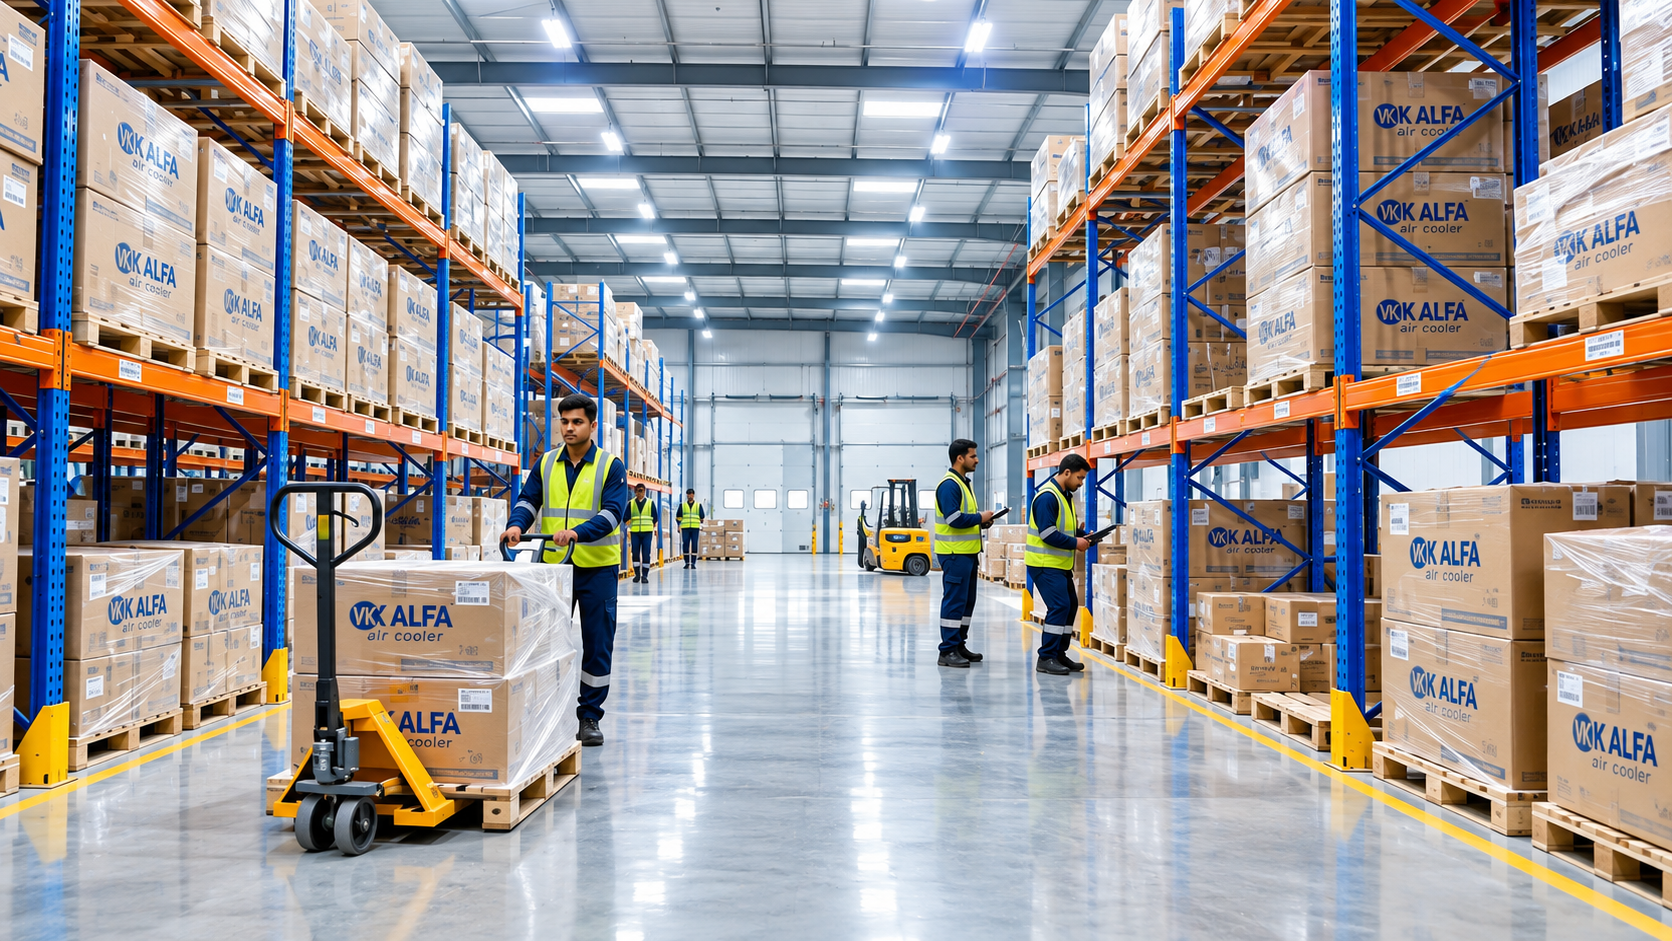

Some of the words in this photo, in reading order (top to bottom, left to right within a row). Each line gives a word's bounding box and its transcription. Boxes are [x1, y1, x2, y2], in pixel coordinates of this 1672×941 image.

[1415, 106, 1465, 124] ALFA
[1397, 126, 1415, 136] air
[146, 142, 179, 179] ALFA
[148, 168, 172, 187] coer
[244, 200, 264, 228] ALFA
[1419, 202, 1469, 221] ALFA
[1400, 224, 1417, 233] air
[1422, 224, 1462, 233] cooler
[1592, 210, 1640, 249] ALFA
[1574, 255, 1591, 270] air
[1595, 242, 1633, 264] cooler
[129, 276, 142, 288] air
[144, 256, 176, 288] ALFA
[241, 299, 262, 322] ALFA
[1419, 302, 1469, 321] ALFA
[1400, 323, 1417, 332] air
[1422, 323, 1461, 332] cooler
[1440, 541, 1481, 567] ALFA
[1426, 569, 1438, 580] air
[1443, 570, 1474, 583] cooler
[136, 594, 167, 618] ALFA
[228, 589, 250, 610] ALFA
[122, 623, 135, 633] air
[138, 618, 162, 630] cooler
[390, 605, 453, 628] ALFA
[367, 630, 388, 641] air
[395, 630, 443, 642] cooler
[1439, 676, 1478, 710] ALFA
[398, 711, 461, 735] ALFA
[1442, 707, 1472, 723] cooler
[408, 736, 452, 748] cooler
[1608, 726, 1658, 767] ALFA
[1592, 756, 1607, 770] air
[1612, 763, 1651, 784] cooler
